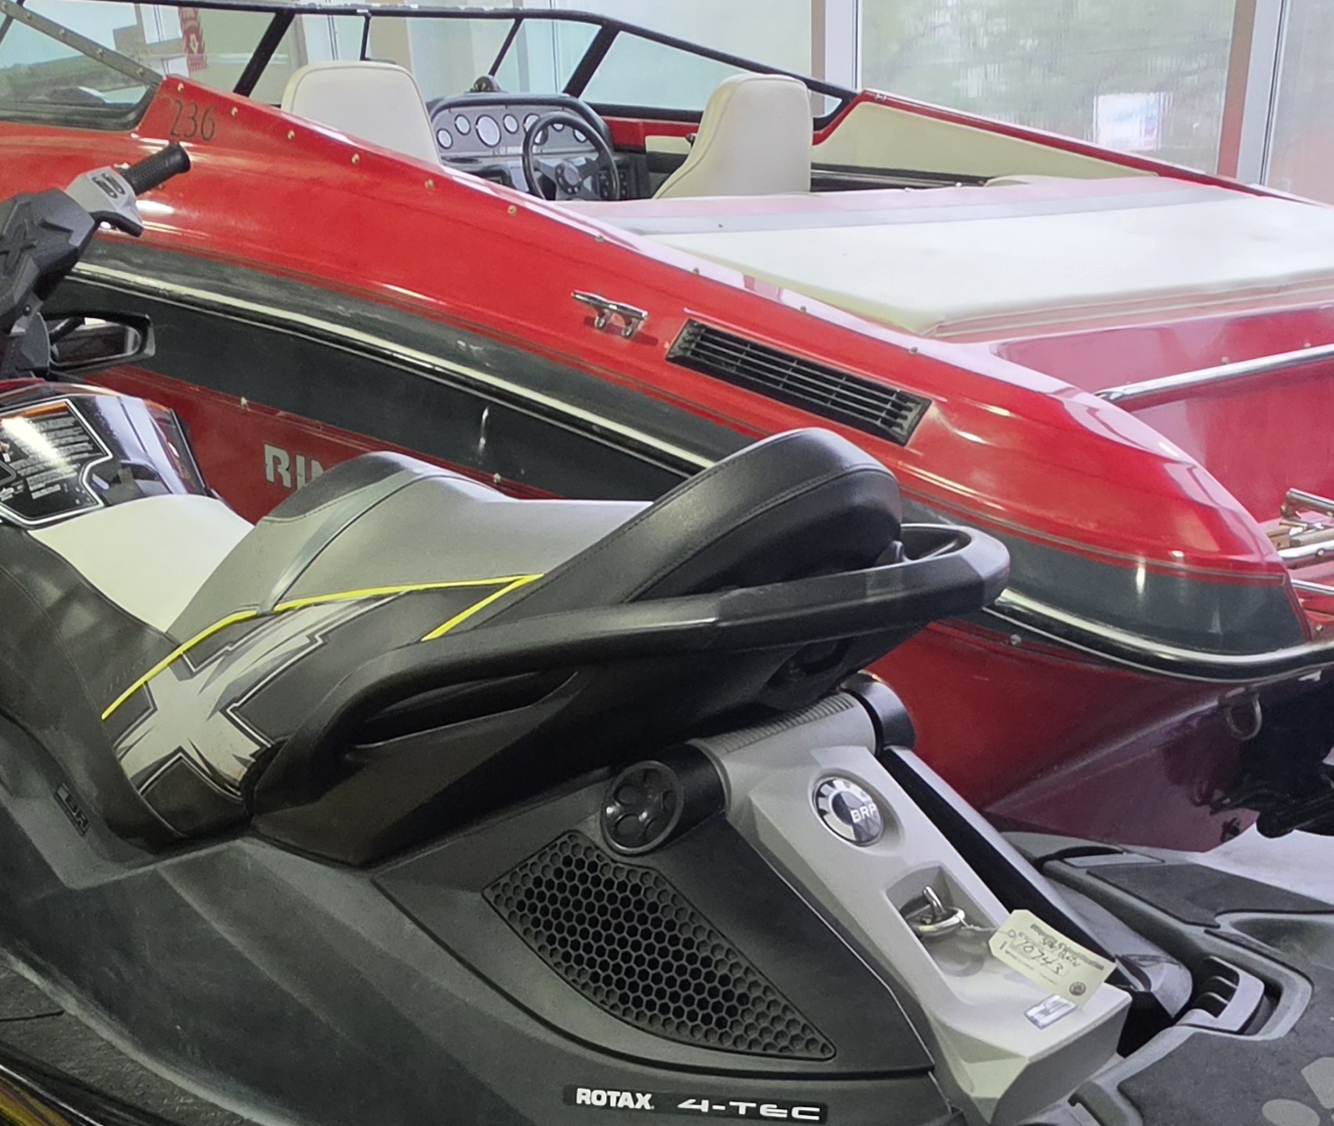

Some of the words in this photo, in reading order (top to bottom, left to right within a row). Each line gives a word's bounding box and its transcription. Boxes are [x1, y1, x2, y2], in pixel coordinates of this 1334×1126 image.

[169, 99, 216, 142] 236
[850, 802, 878, 824] BRP
[576, 1088, 652, 1110] ROTAX
[677, 1099, 821, 1121] 4-TEC
